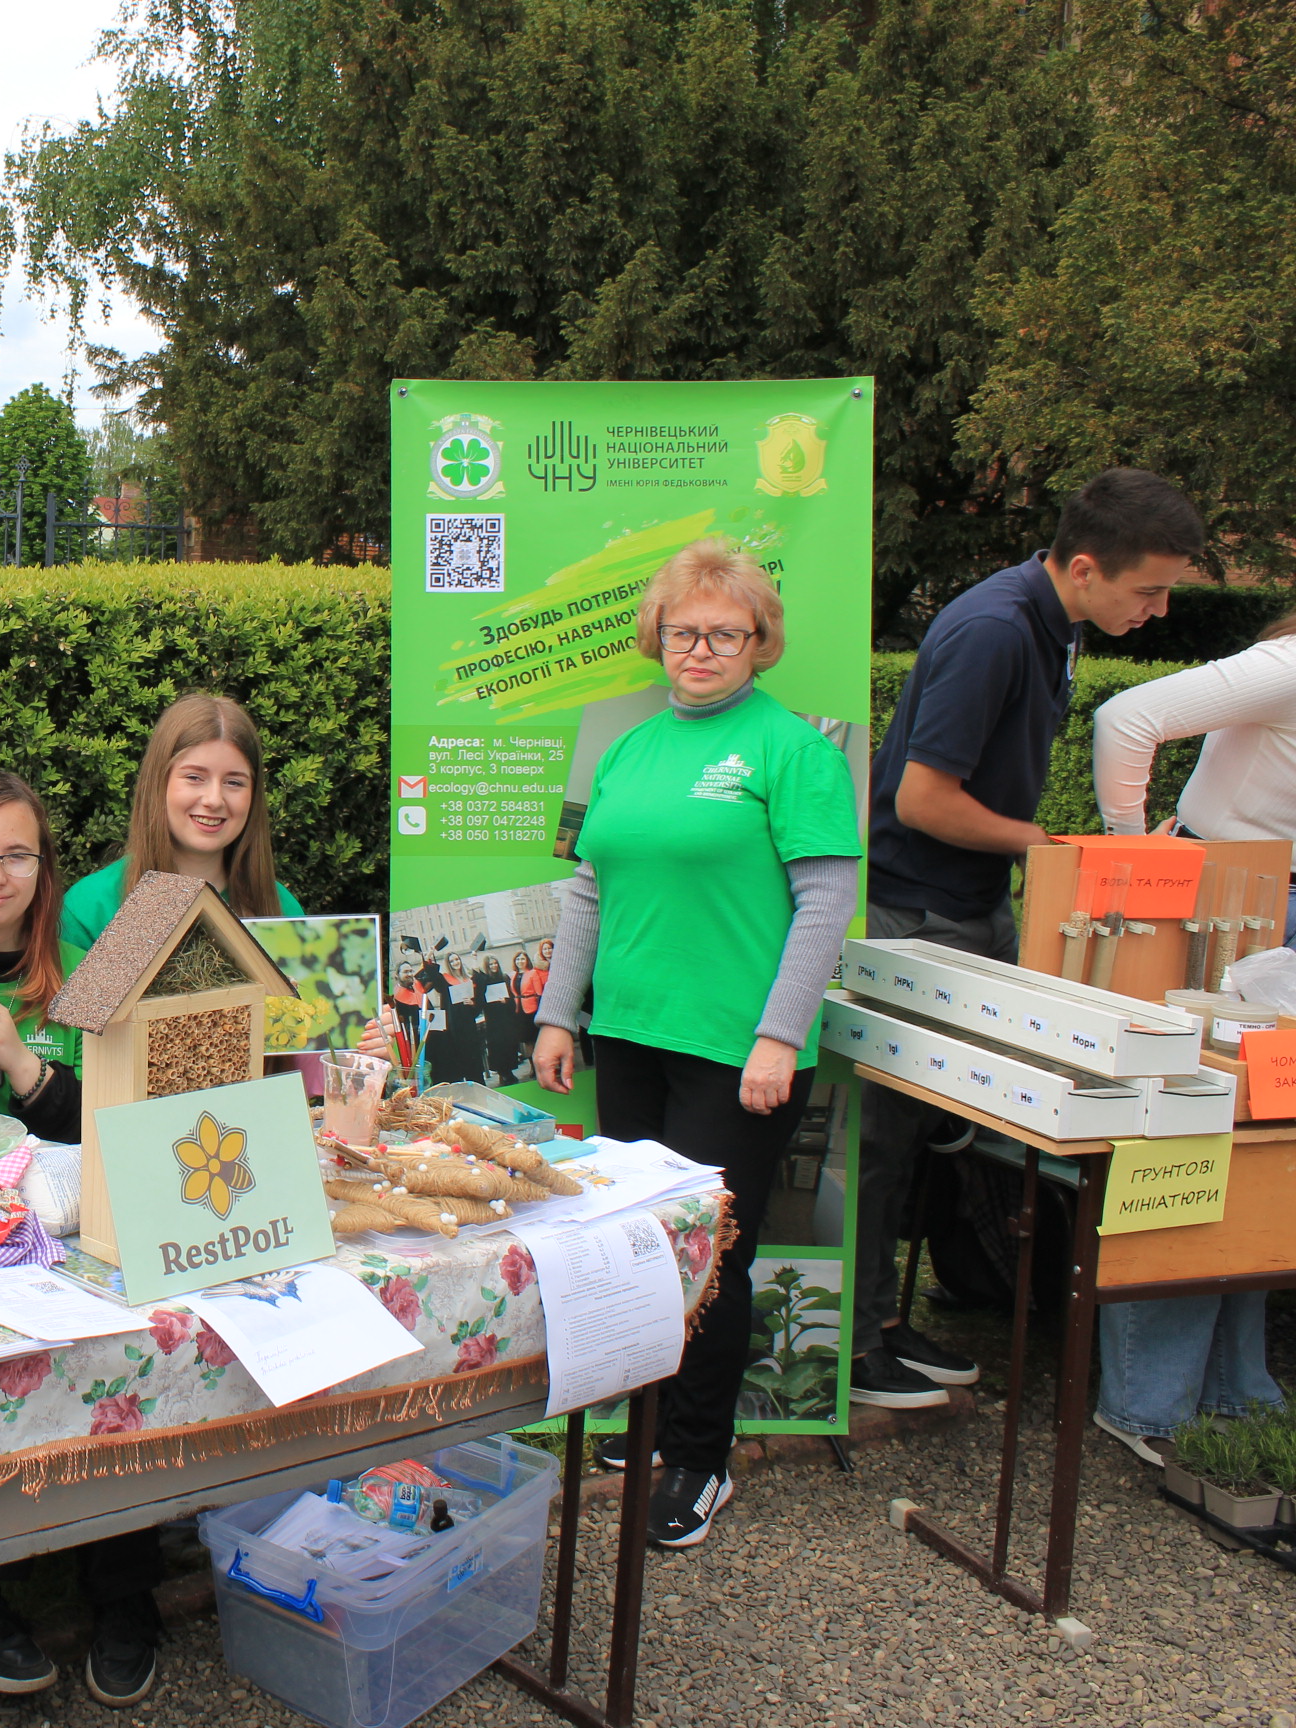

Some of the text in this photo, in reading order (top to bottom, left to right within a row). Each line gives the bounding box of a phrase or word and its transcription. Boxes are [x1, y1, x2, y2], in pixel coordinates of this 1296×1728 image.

[606, 424, 719, 439] ЧЕРНІВЕЦЬКИЙ
[606, 440, 728, 455] НАЦІОНАЛЬНИЙ
[607, 457, 705, 469] УНІВЕРСИТЕТ
[606, 478, 728, 488] ІМЕНІ ЮРІЯ ФЕДЬКОВИЧА
[456, 640, 553, 681] ПРОФЕСІЮ,
[476, 636, 636, 700] ЕКОЛОГІЇ ТА БІОМО
[428, 736, 566, 749] Адреса: м. Чернівці,
[429, 750, 564, 763] вул. Лесі Українки, 25
[429, 763, 544, 777] 3 корпус, 3 поверх
[428, 782, 564, 796] ecology@chnu.edu.ua
[440, 801, 545, 812] +38 0372 584831
[440, 816, 546, 827] +38 097 0472248
[440, 830, 546, 841] +38 050 1318270
[1136, 879, 1152, 887] ТА
[1131, 1160, 1215, 1184] ГРУНТОВІ
[1119, 1189, 1219, 1215] МІНІАТЮРИ
[692, 1474, 719, 1521] PUMA
